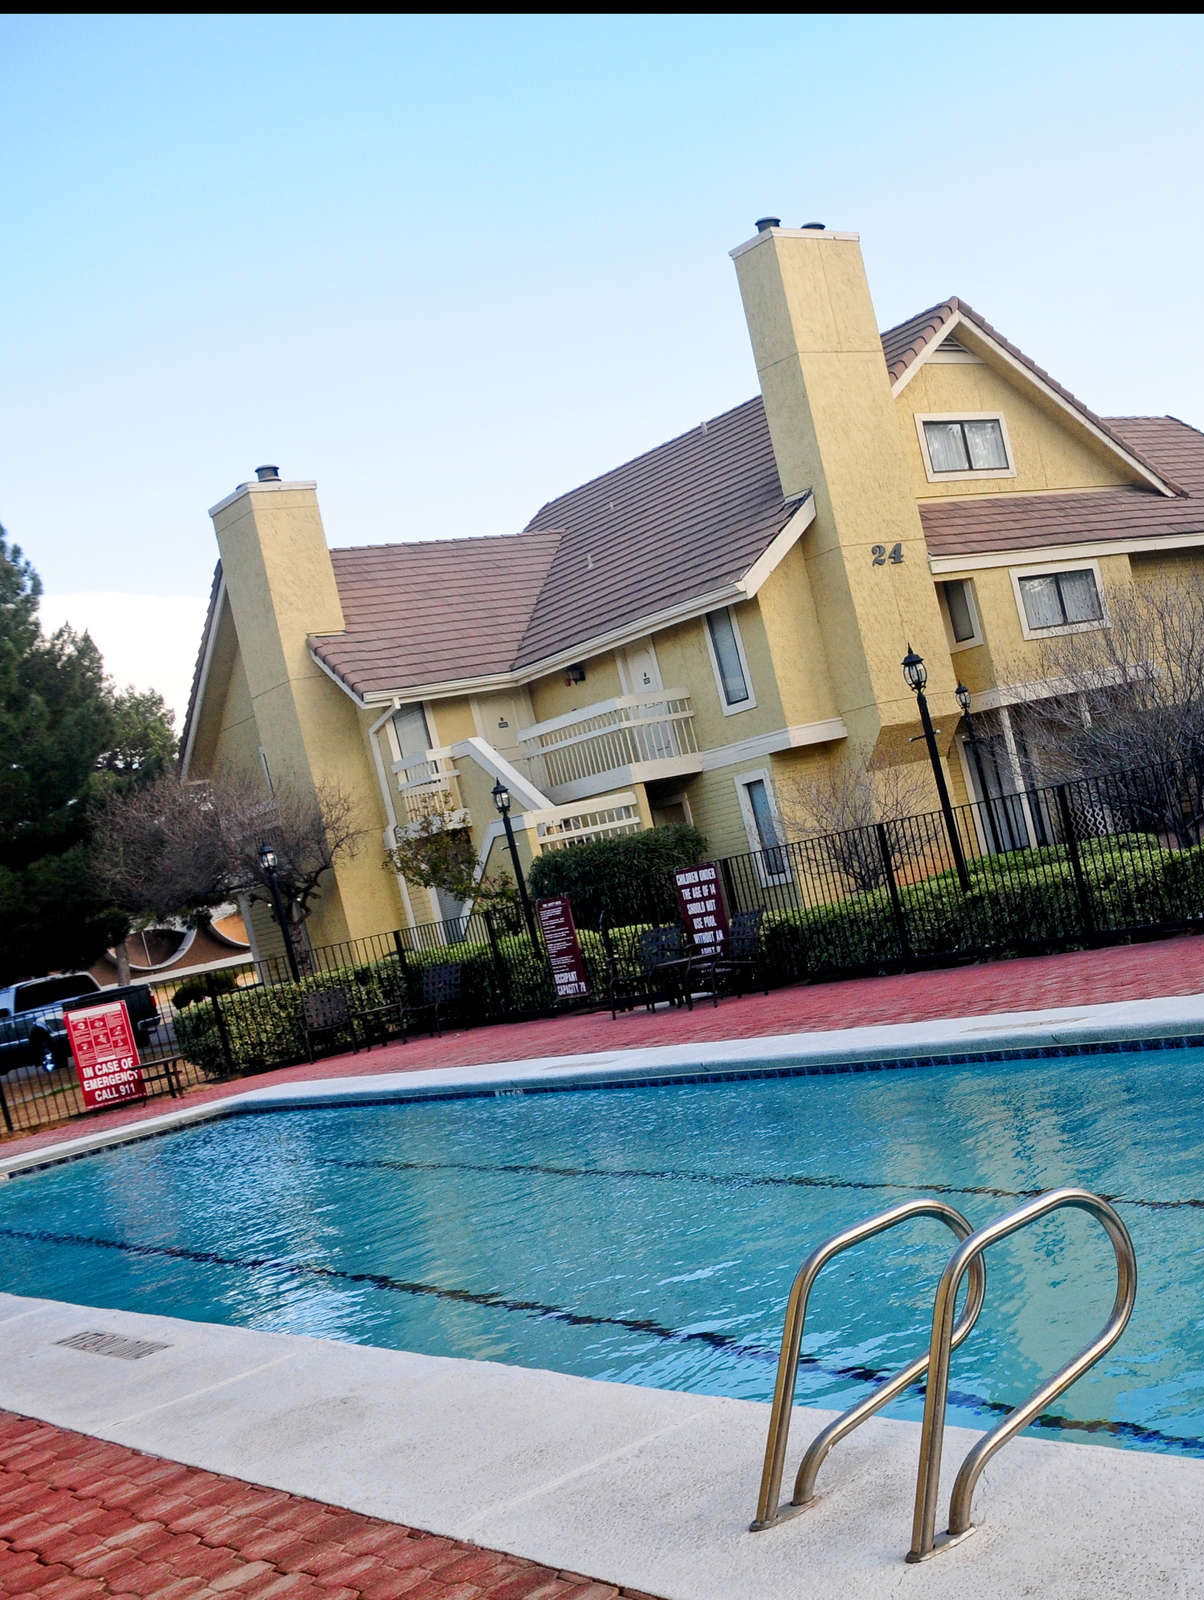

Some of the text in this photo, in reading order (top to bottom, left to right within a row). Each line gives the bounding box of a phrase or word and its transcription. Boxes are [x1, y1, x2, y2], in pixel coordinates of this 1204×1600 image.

[871, 543, 904, 567] 24
[681, 888, 692, 900] THE
[692, 886, 702, 899] AGE
[702, 884, 709, 897] OF
[693, 915, 717, 930] USE POOL
[83, 1066, 94, 1078] IN
[95, 1060, 120, 1076] CASE
[121, 1057, 133, 1070] OF
[83, 1070, 138, 1091] EMERGENCY
[95, 1082, 135, 1101] CALL 911
